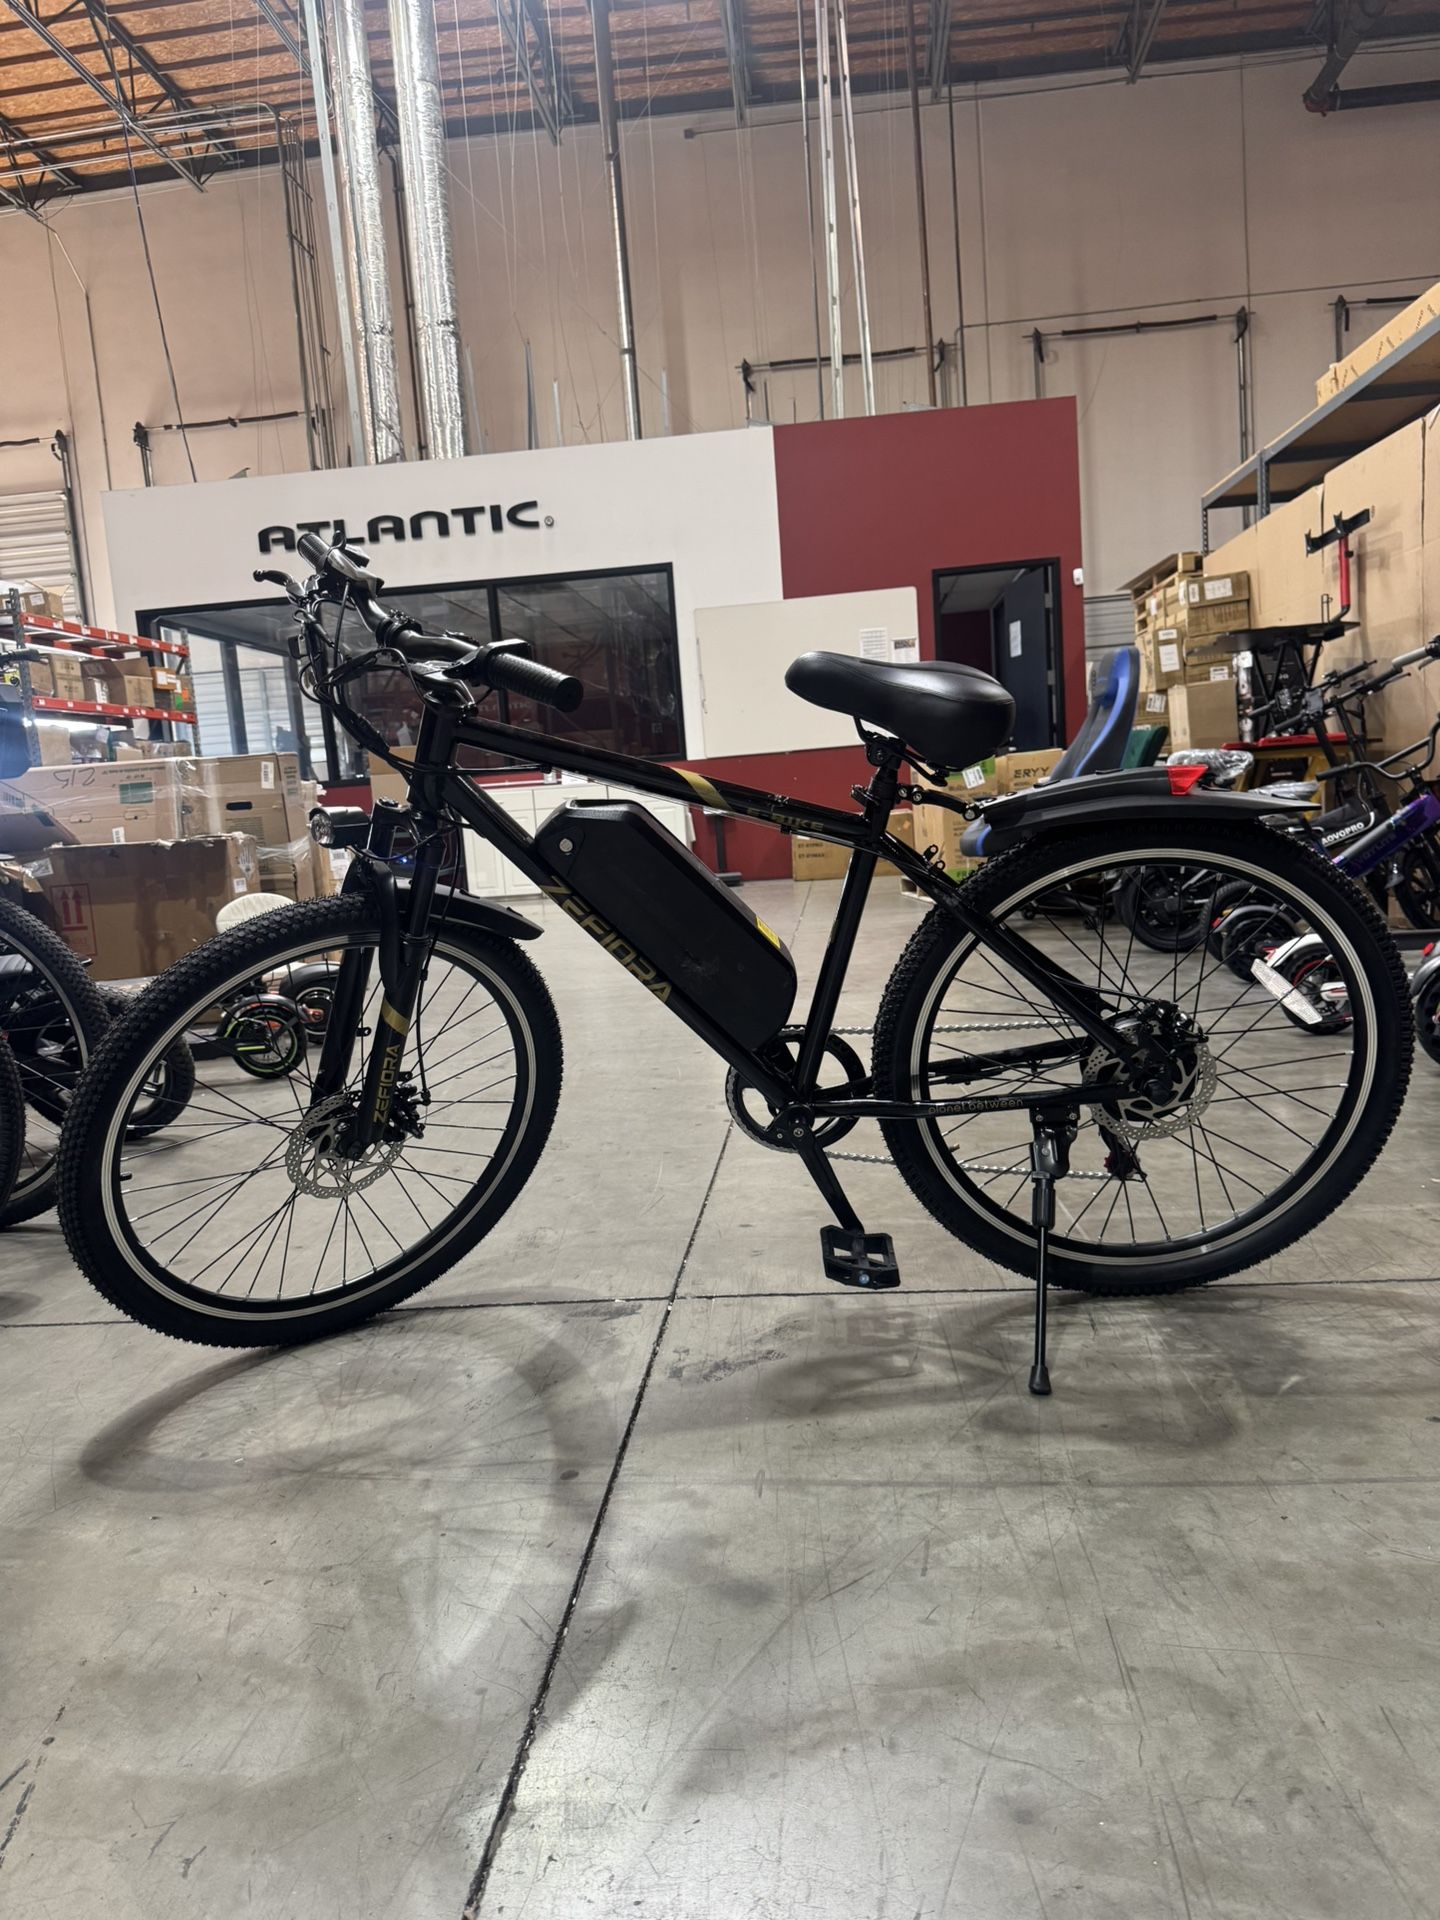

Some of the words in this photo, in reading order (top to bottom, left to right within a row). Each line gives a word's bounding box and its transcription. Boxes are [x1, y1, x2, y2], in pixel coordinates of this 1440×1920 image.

[258, 500, 540, 553] ATLANTIC
[1321, 822, 1365, 846] AOVOPRO
[540, 875, 672, 1003] ZEFIORA
[373, 1043, 401, 1123] ZEFIORA
